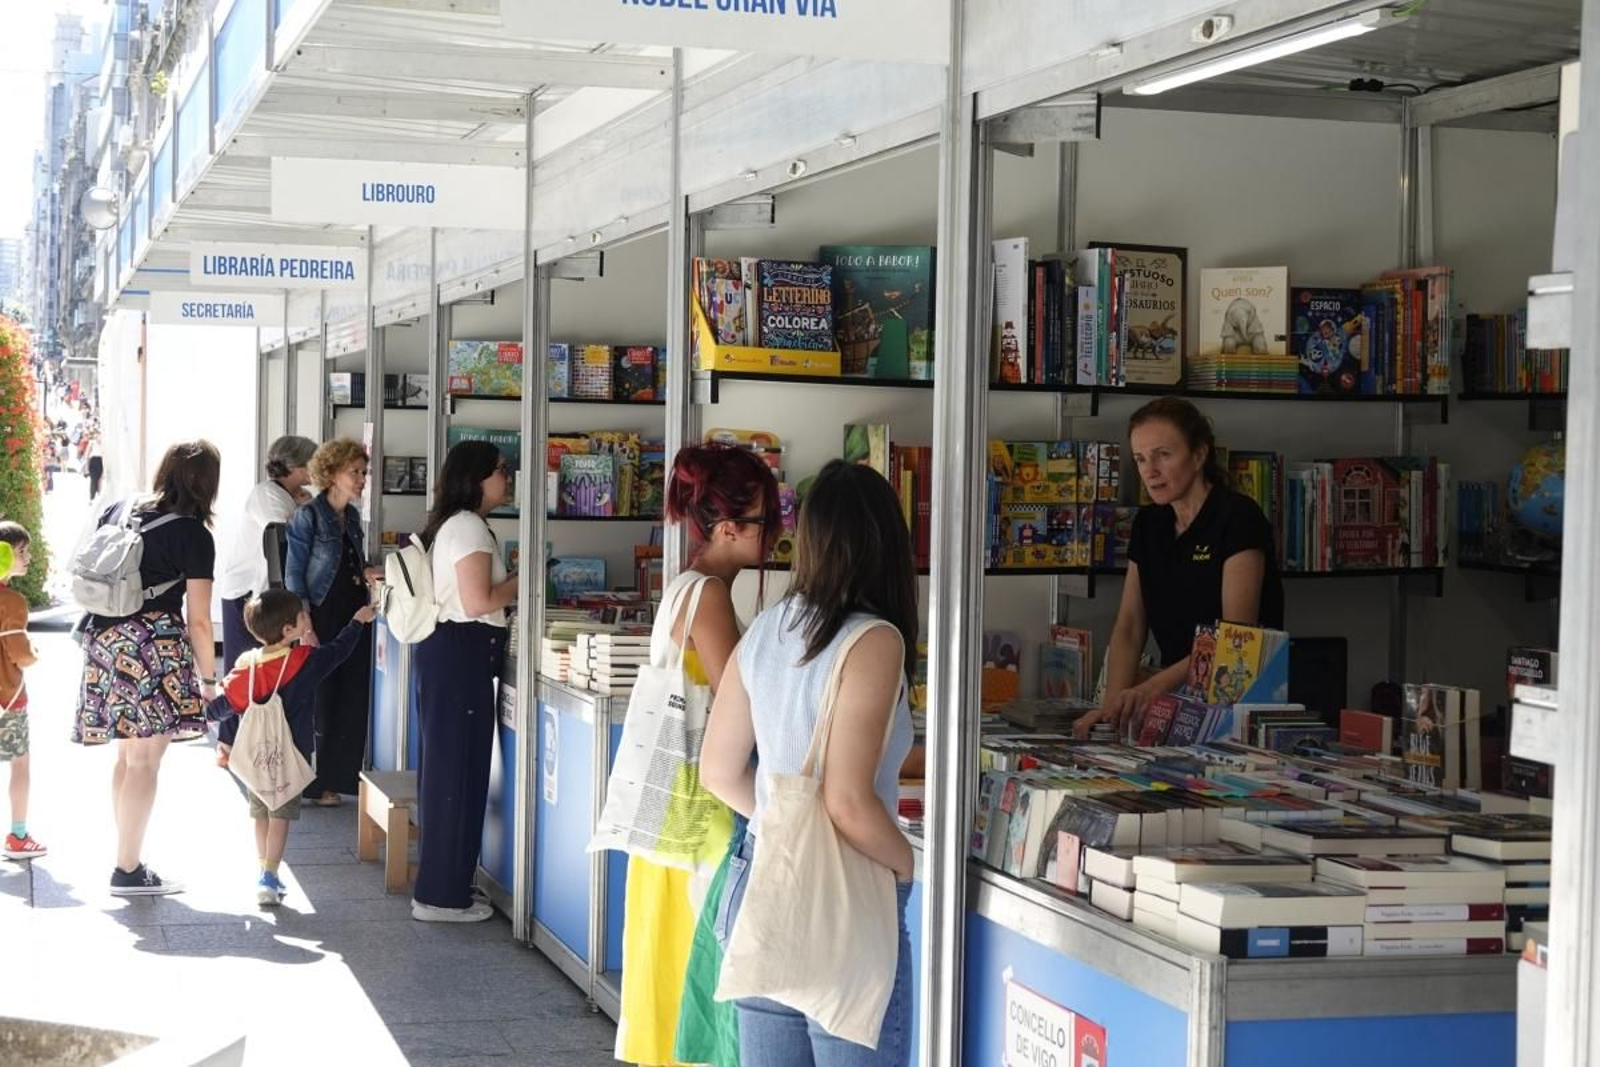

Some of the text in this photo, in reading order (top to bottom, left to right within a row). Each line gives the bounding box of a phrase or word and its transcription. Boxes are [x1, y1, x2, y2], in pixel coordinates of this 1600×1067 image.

[362, 183, 436, 203] LIBROURO
[203, 254, 355, 280] LIBRARÍA PEDREIRA
[181, 301, 255, 319] SECRETARÍA
[1310, 300, 1341, 311] ESPACIO
[767, 316, 829, 330] COLOREA
[1010, 1000, 1066, 1048] CONCELLO
[1016, 1034, 1057, 1067] DE VIGO
